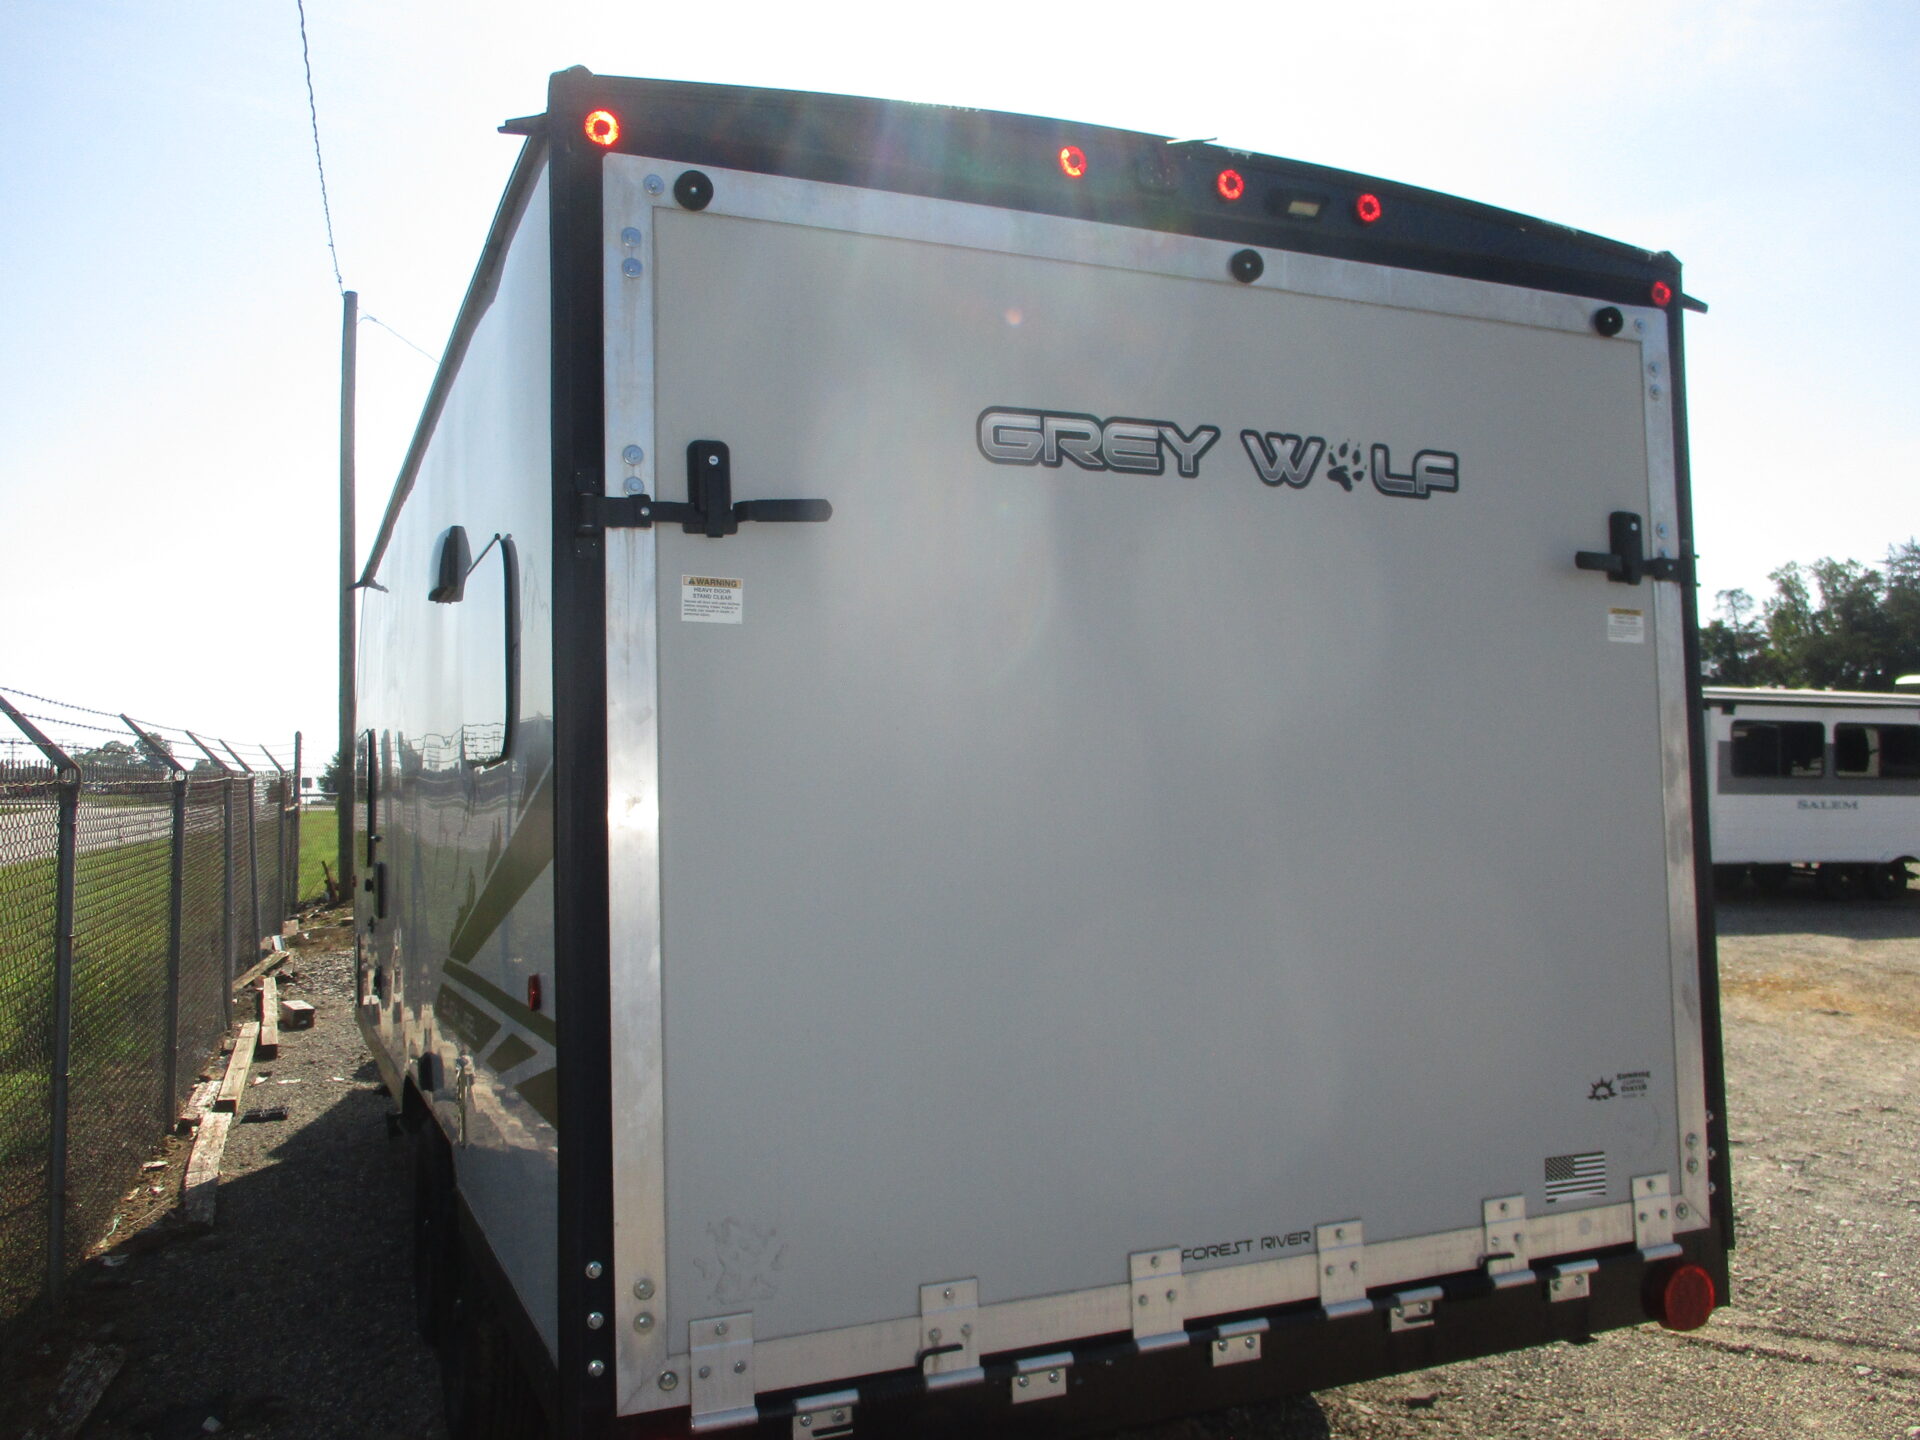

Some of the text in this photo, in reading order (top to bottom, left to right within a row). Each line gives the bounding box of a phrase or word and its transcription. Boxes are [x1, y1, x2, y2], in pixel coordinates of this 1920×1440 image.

[976, 405, 1221, 478] GREY
[695, 576, 737, 588] WARNING
[1797, 799, 1858, 810] SALEM
[1181, 1231, 1311, 1262] FOREST RIVER
